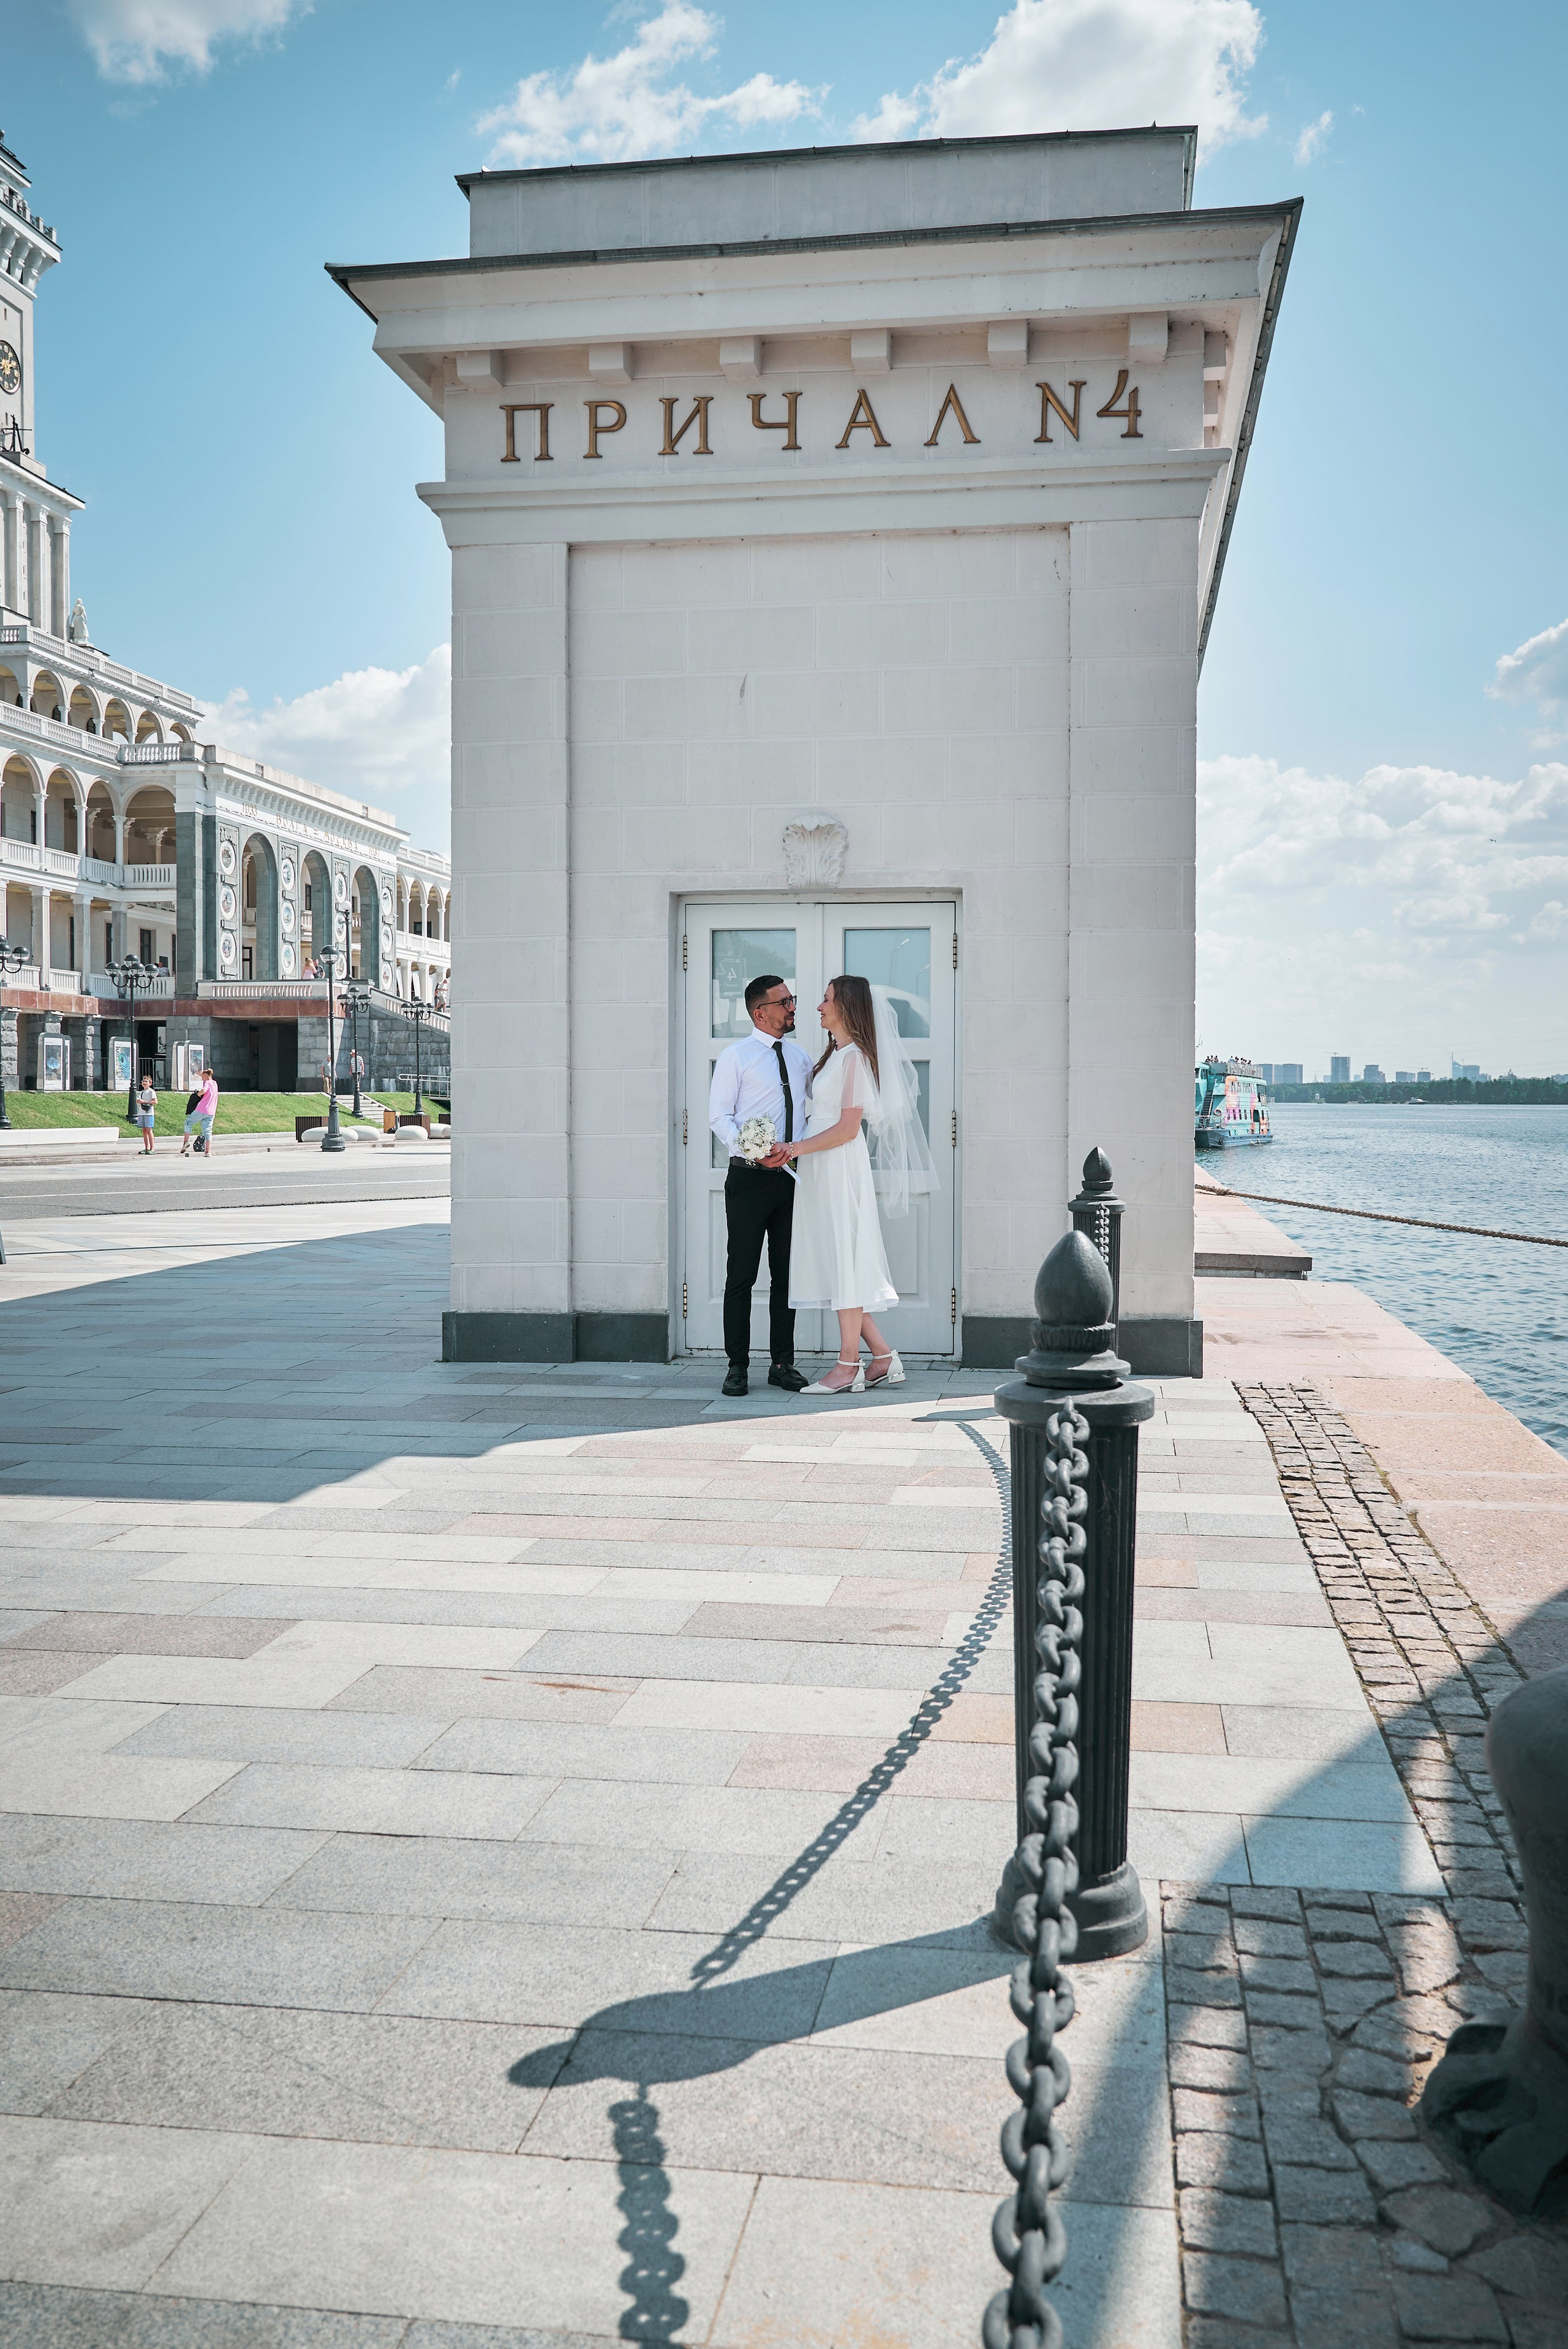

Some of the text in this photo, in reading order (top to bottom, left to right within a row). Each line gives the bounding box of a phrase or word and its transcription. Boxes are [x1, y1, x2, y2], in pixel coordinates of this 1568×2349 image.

[499, 383, 981, 463] ПРИЧАЛ
[276, 814, 307, 834] ВОЛГА
[324, 831, 358, 850] МОСКВА
